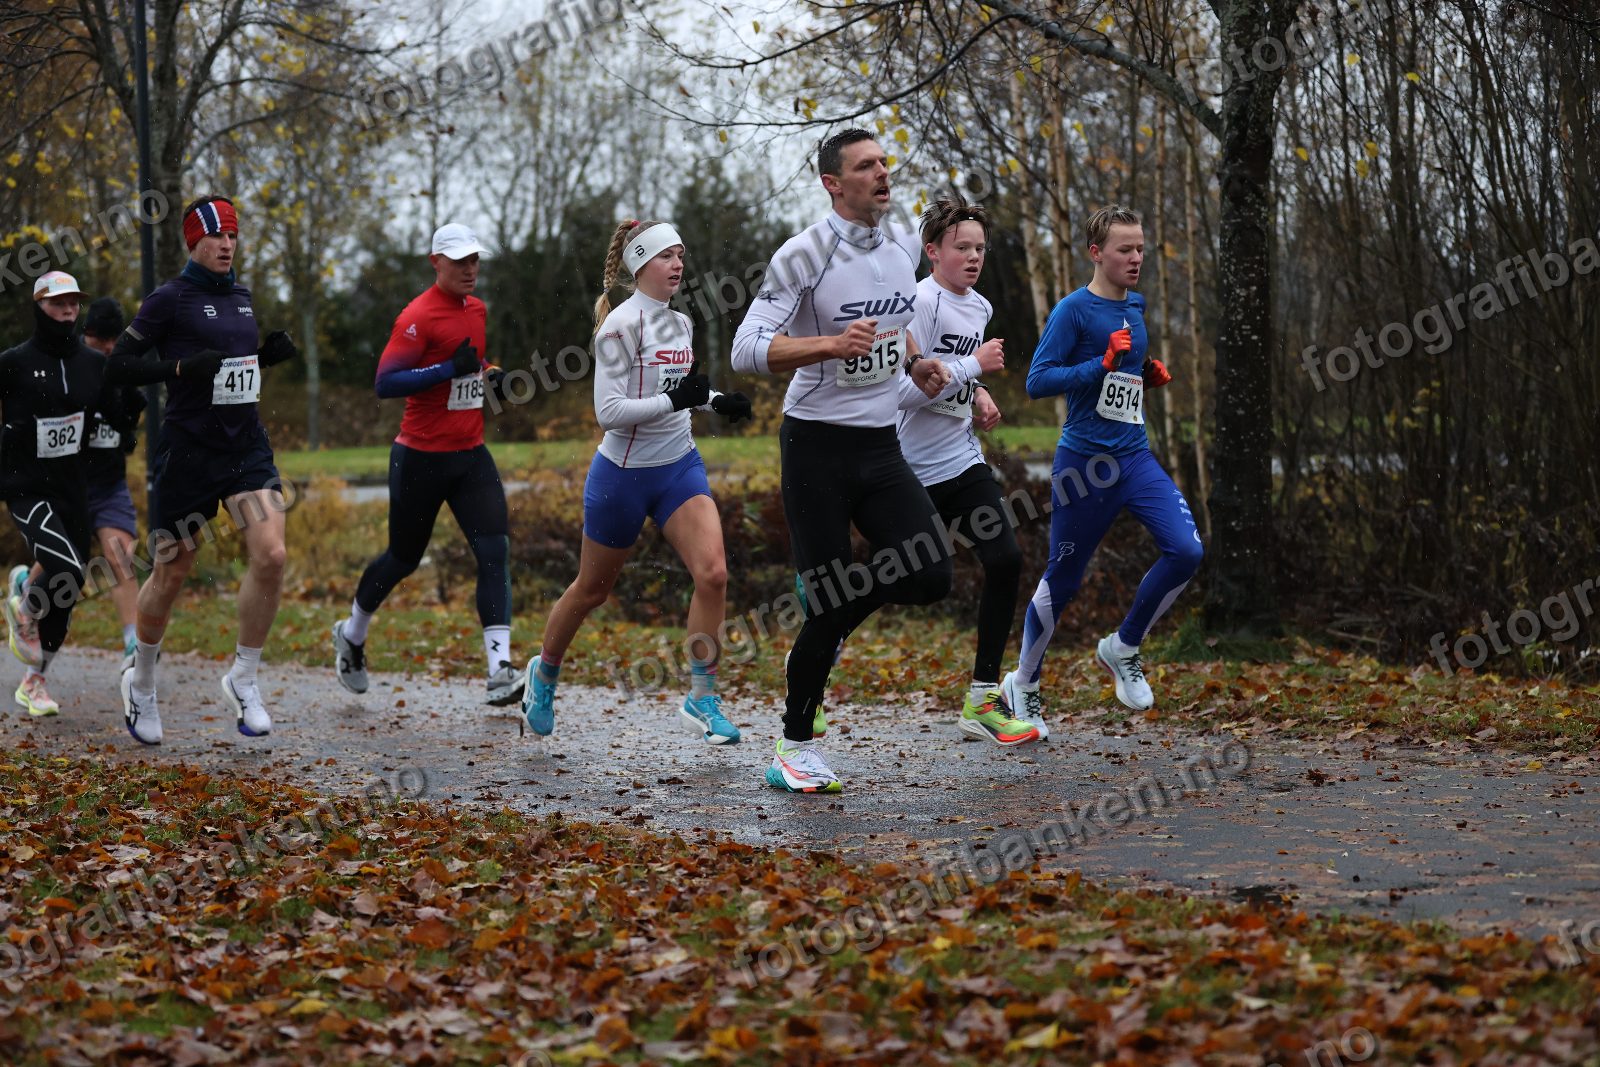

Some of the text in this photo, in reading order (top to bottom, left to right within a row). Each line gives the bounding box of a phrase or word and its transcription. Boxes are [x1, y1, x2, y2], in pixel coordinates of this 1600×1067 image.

[844, 341, 899, 375] 9515
[225, 369, 255, 393] 417
[1104, 383, 1140, 412] 9514
[48, 424, 77, 449] 362
